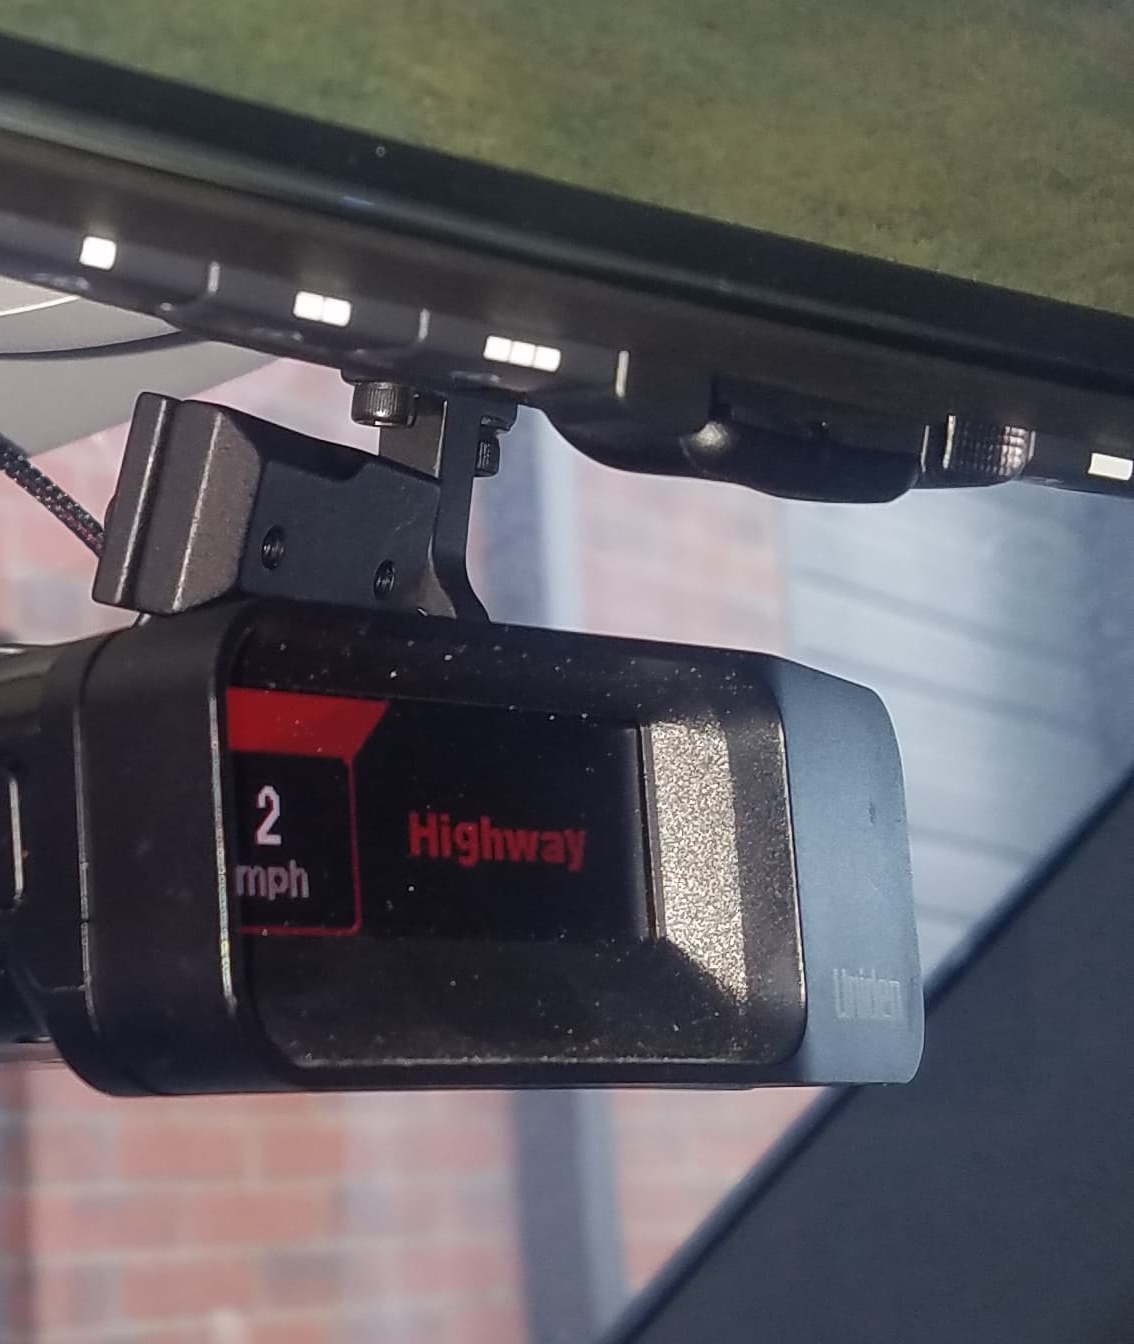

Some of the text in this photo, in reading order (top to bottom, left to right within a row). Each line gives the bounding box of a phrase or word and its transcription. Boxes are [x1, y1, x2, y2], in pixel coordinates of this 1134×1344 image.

[256, 785, 282, 846] 2
[408, 810, 587, 871] Highway
[235, 859, 309, 900] mph
